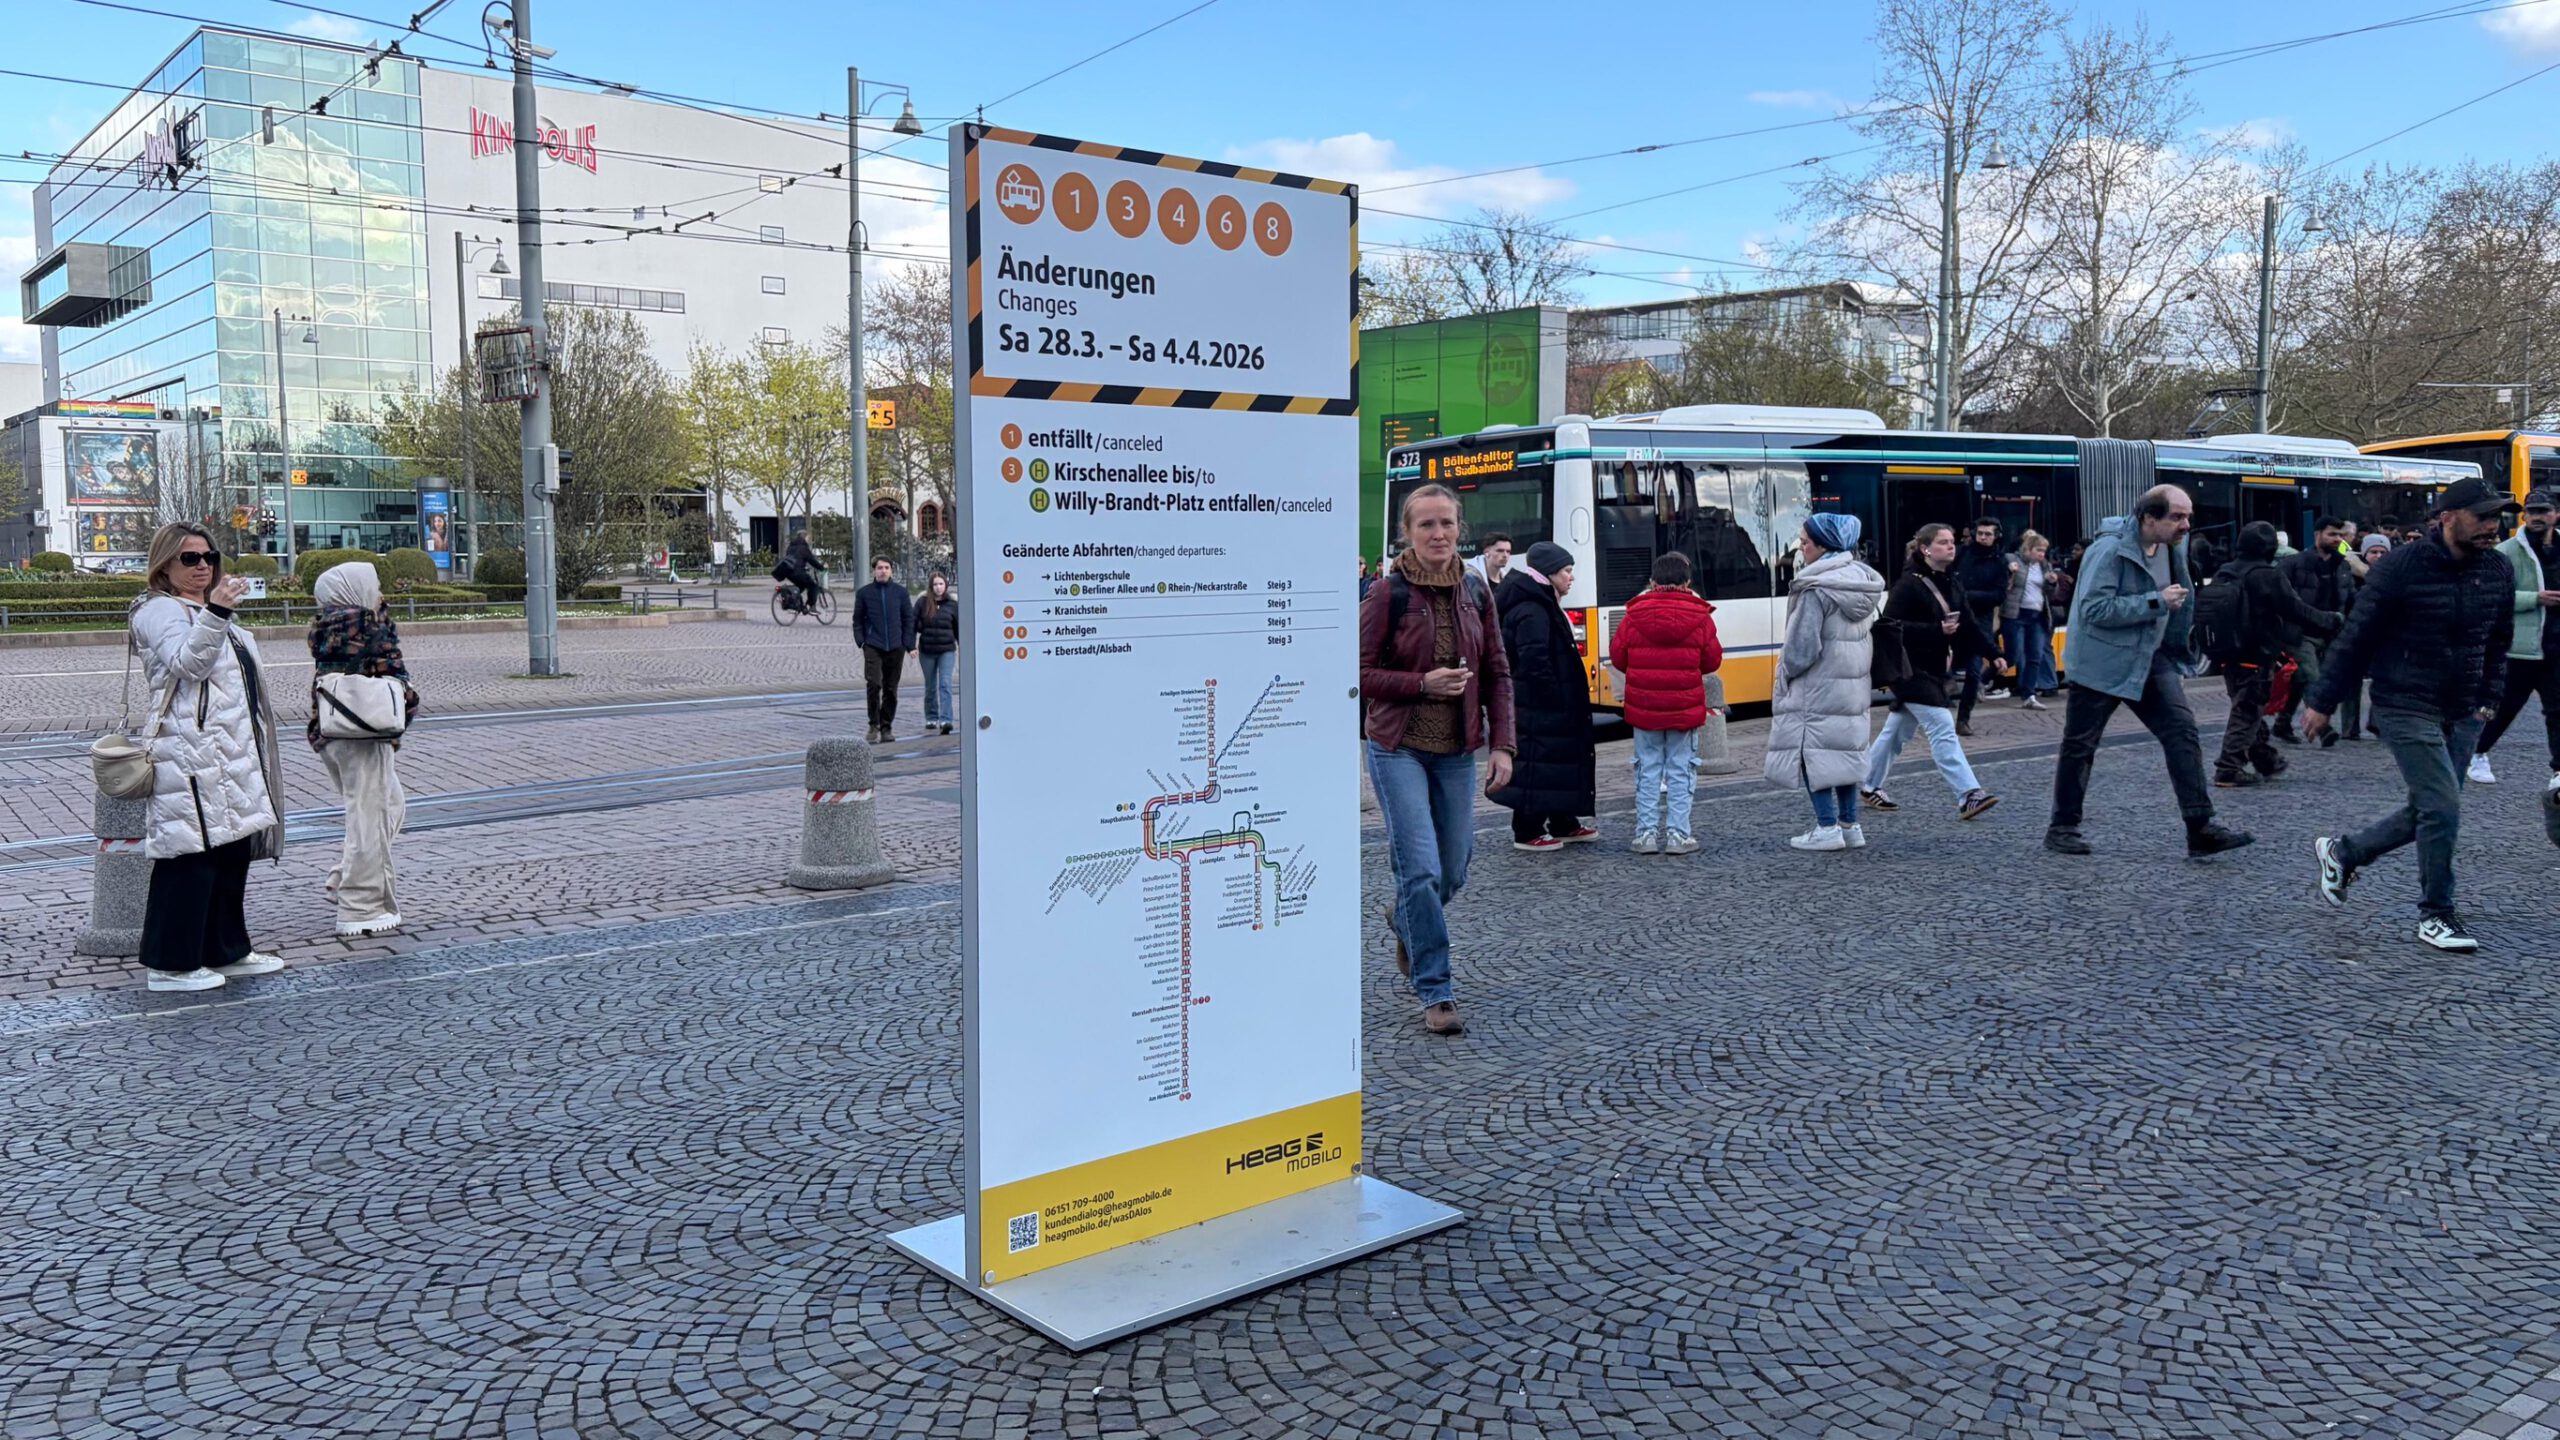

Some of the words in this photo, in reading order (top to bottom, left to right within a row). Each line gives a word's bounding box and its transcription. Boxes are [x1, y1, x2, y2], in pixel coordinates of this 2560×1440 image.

[469, 105, 597, 175] KINPOLIS
[1070, 188, 1081, 215] 1
[1122, 196, 1135, 221] 3
[1172, 203, 1186, 228] 4
[1220, 210, 1233, 234] 6
[1266, 217, 1279, 240] 8
[997, 244, 1156, 299] Änderungen
[998, 288, 1078, 320] Changes
[999, 323, 1030, 354] Sa
[1038, 326, 1104, 359] 28.3.
[1129, 334, 1156, 363] Sa
[1162, 338, 1265, 370] 4.4.2026
[883, 410, 894, 426] 5
[1008, 430, 1016, 443] 1
[1401, 452, 1420, 467] 373
[1443, 450, 1514, 467] Böllenfalltor
[1455, 460, 1514, 476] Südbahnhof
[1008, 464, 1016, 476] 3
[1054, 462, 1168, 483] Kirschenallee
[1054, 491, 1205, 515] Willy-Brandt-Platz
[1002, 543, 1070, 557] Geänderte
[1177, 545, 1227, 559] departures:
[1054, 570, 1131, 583] Lichtenbergschule
[1054, 586, 1068, 596] via
[1082, 585, 1115, 595] Berliner
[1117, 583, 1138, 593] Allee
[1140, 583, 1155, 593] und
[1168, 580, 1248, 593] Rhein-/Neckarstraße
[1267, 580, 1286, 591] Steig
[1054, 604, 1108, 616] Kranichstein
[1267, 599, 1286, 610] Steig
[1054, 625, 1097, 637] Arheilgen
[1267, 617, 1286, 628] Steig
[1055, 643, 1132, 656] Eberstadt/Alsbach
[1267, 636, 1286, 646] Steig
[1044, 1203, 1071, 1218] 06151
[1071, 1190, 1115, 1210] 709-4000
[1044, 1187, 1173, 1230] kundendialog@heagmobilo.de
